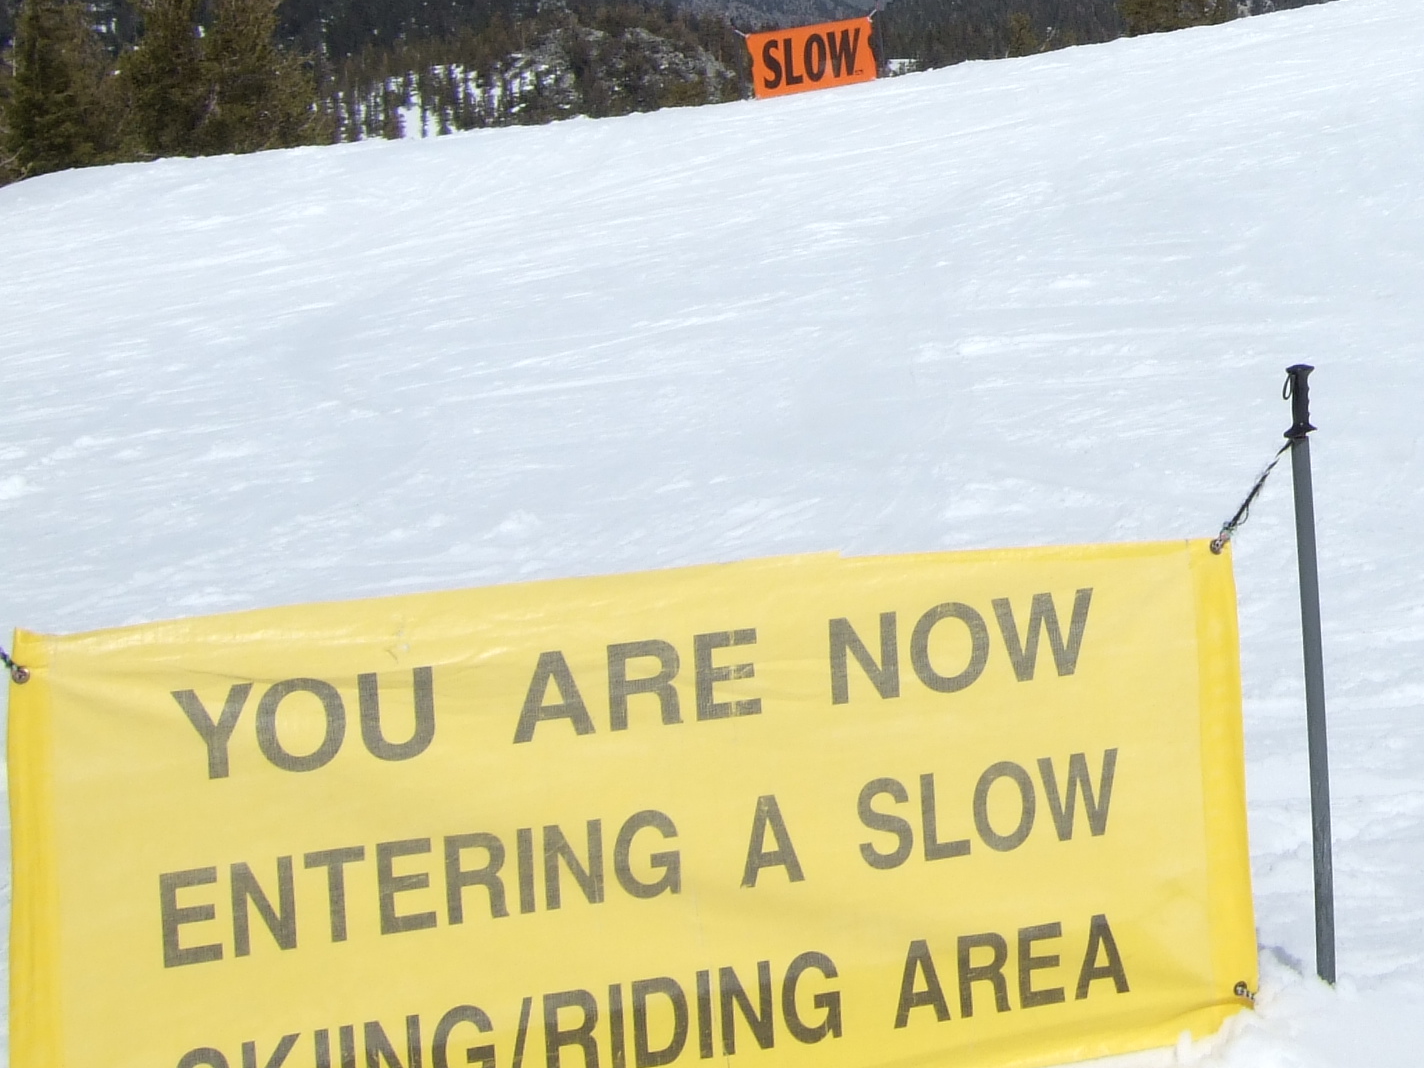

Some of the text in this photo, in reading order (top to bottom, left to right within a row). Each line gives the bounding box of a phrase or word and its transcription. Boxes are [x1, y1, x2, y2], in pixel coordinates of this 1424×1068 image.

[762, 27, 861, 90] SLOW
[170, 587, 1094, 780] YOU ARE NOW
[159, 747, 1118, 969] ENTERING A SLOW
[176, 913, 1130, 1068] NG/RIDING AREA
